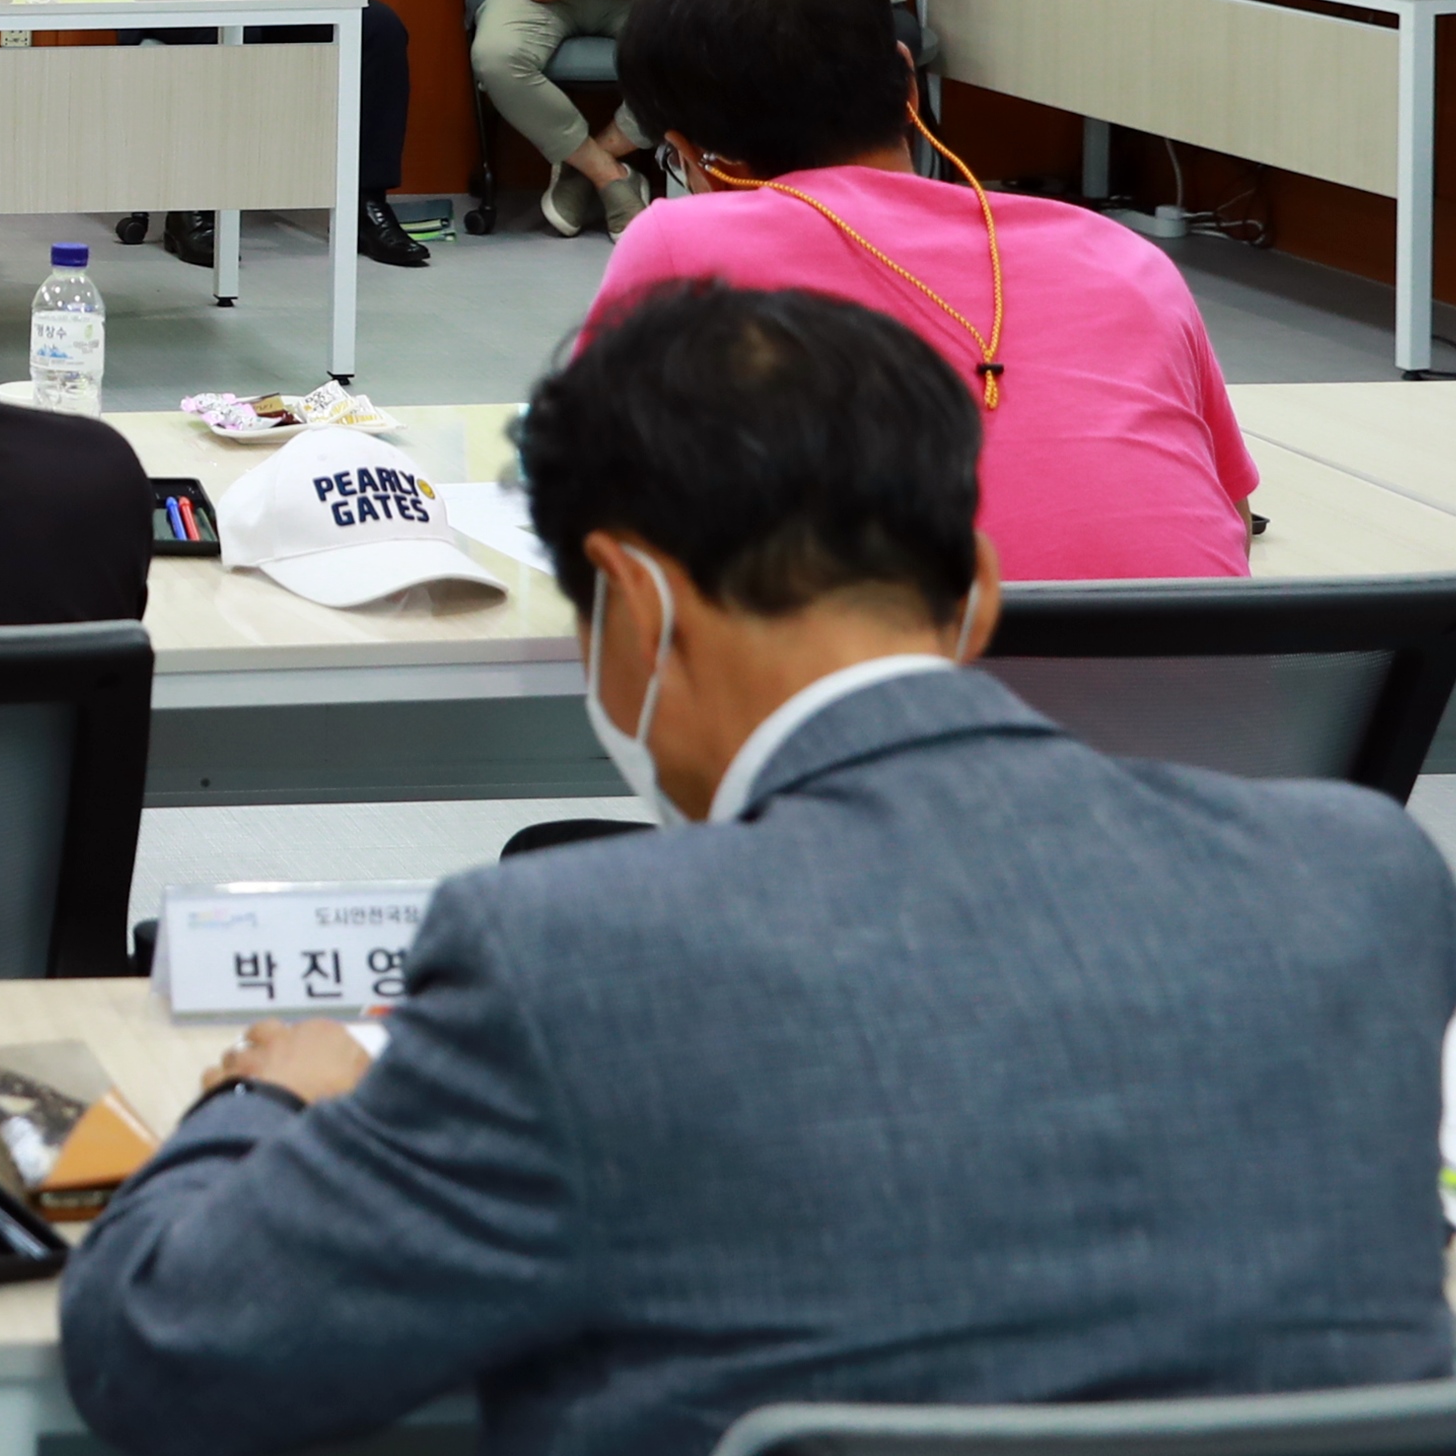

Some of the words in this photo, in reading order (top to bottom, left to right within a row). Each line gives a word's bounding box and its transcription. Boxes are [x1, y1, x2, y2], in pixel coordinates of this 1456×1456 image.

[312, 466, 420, 502] PEARLY
[331, 493, 430, 527] GATES
[234, 947, 408, 1001] 박진영
